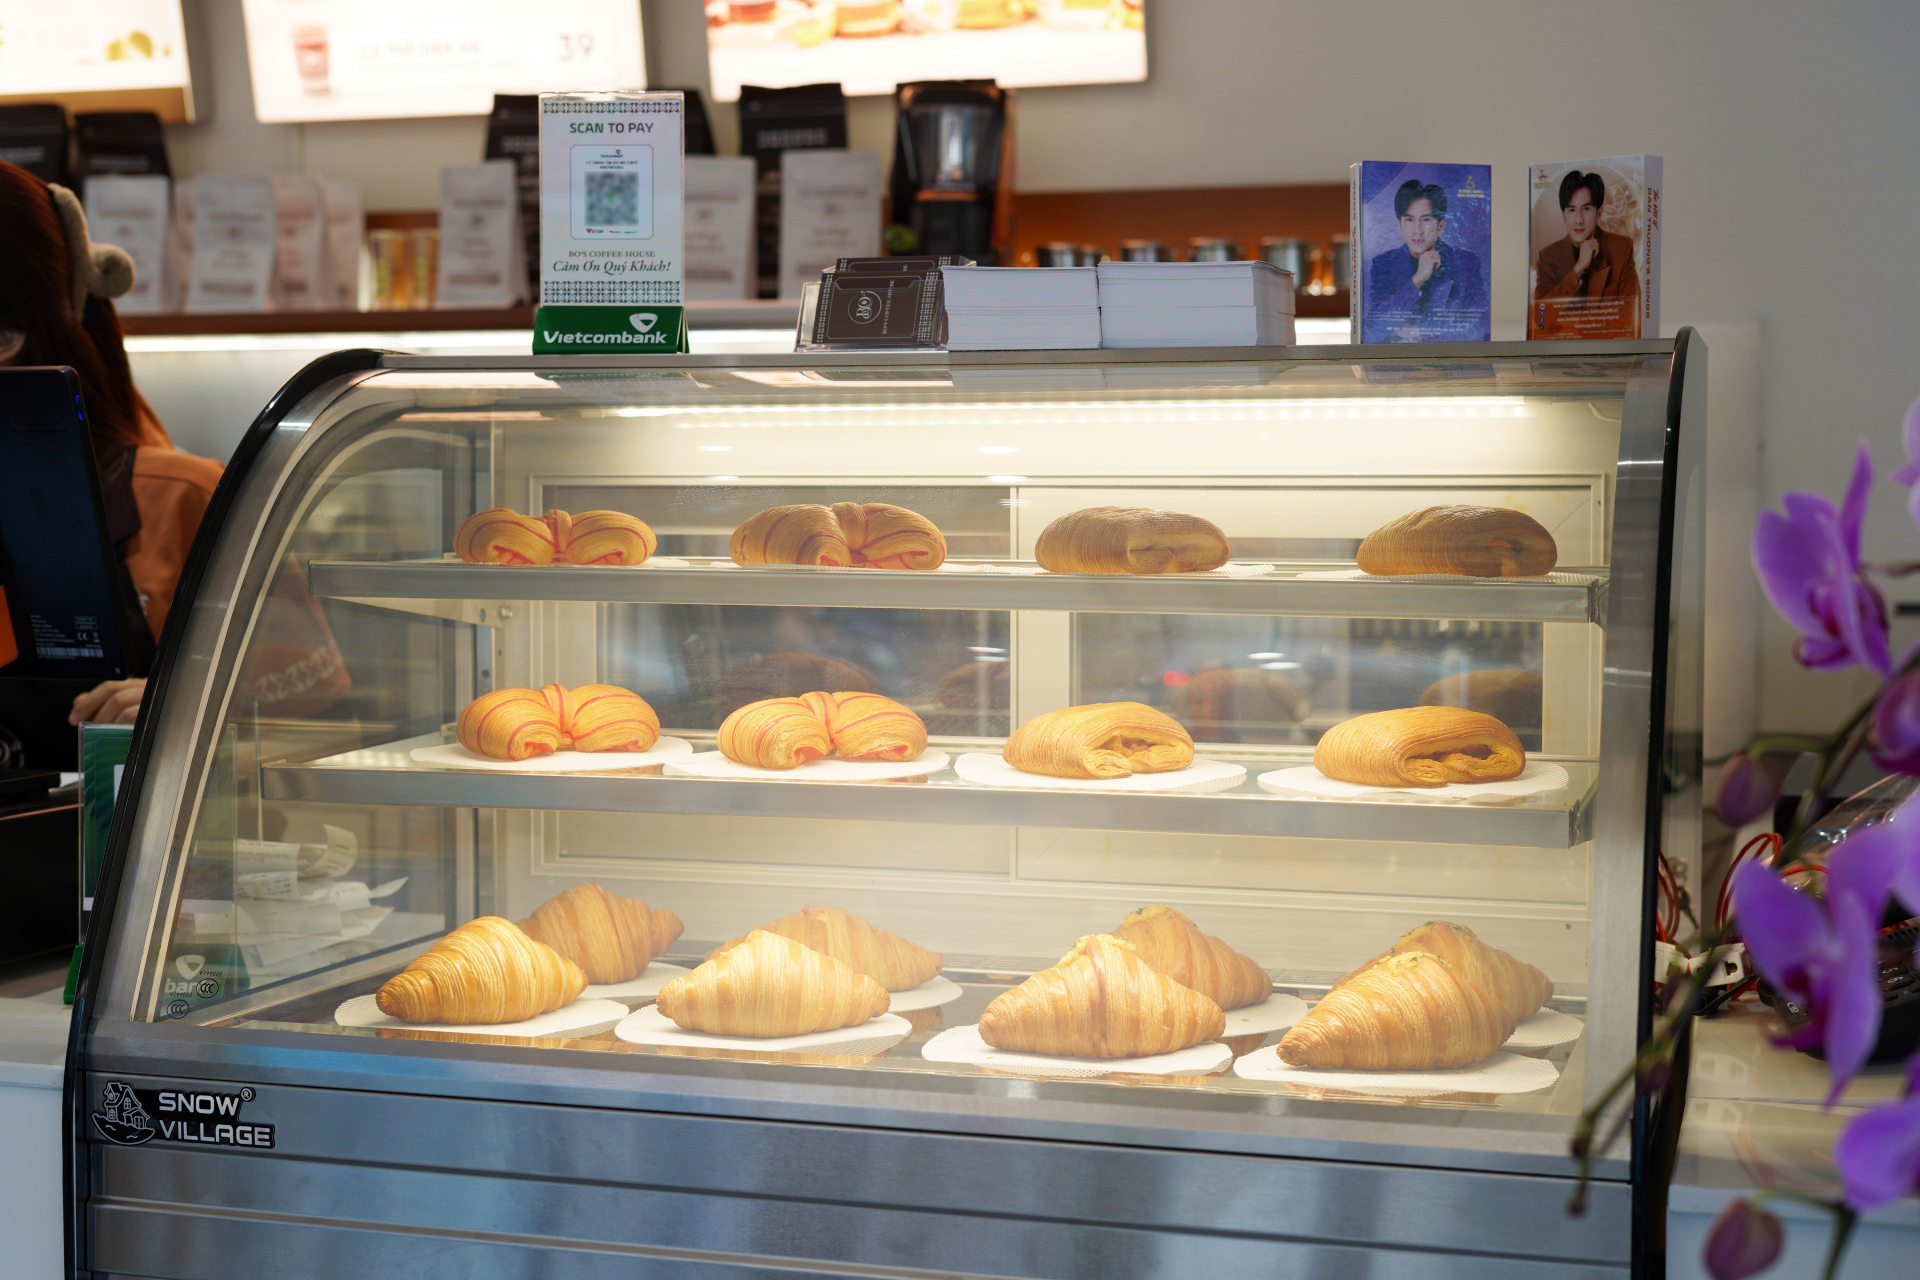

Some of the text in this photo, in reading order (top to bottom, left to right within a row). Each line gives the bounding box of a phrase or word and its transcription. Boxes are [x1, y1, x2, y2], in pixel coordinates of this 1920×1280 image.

[558, 33, 595, 62] 39
[570, 122, 654, 134] SCAN TO PAY
[568, 250, 656, 258] BO'S COFFEE HOUSE
[553, 260, 580, 272] Cảm
[603, 260, 627, 276] Quý
[629, 260, 671, 272] Khách!
[543, 331, 668, 344] Vietcombank
[159, 1092, 239, 1116] SNOW
[159, 1120, 271, 1147] VILLAGE
